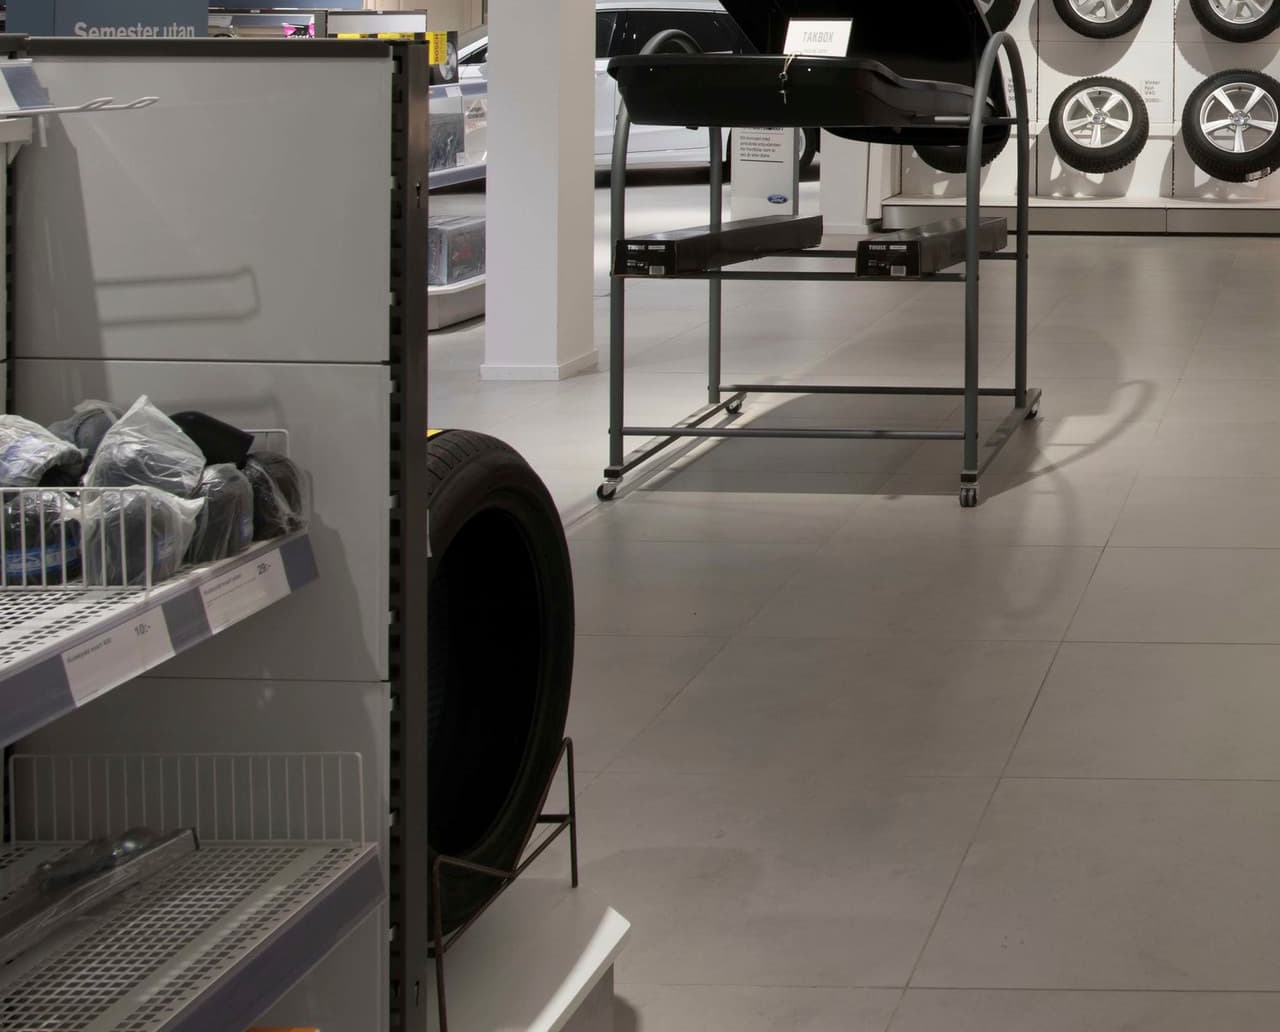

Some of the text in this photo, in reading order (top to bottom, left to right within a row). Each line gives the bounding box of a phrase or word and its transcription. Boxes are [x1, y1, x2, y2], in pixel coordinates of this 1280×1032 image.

[74, 22, 195, 38] Semester utan
[802, 31, 835, 48] TAKBOX
